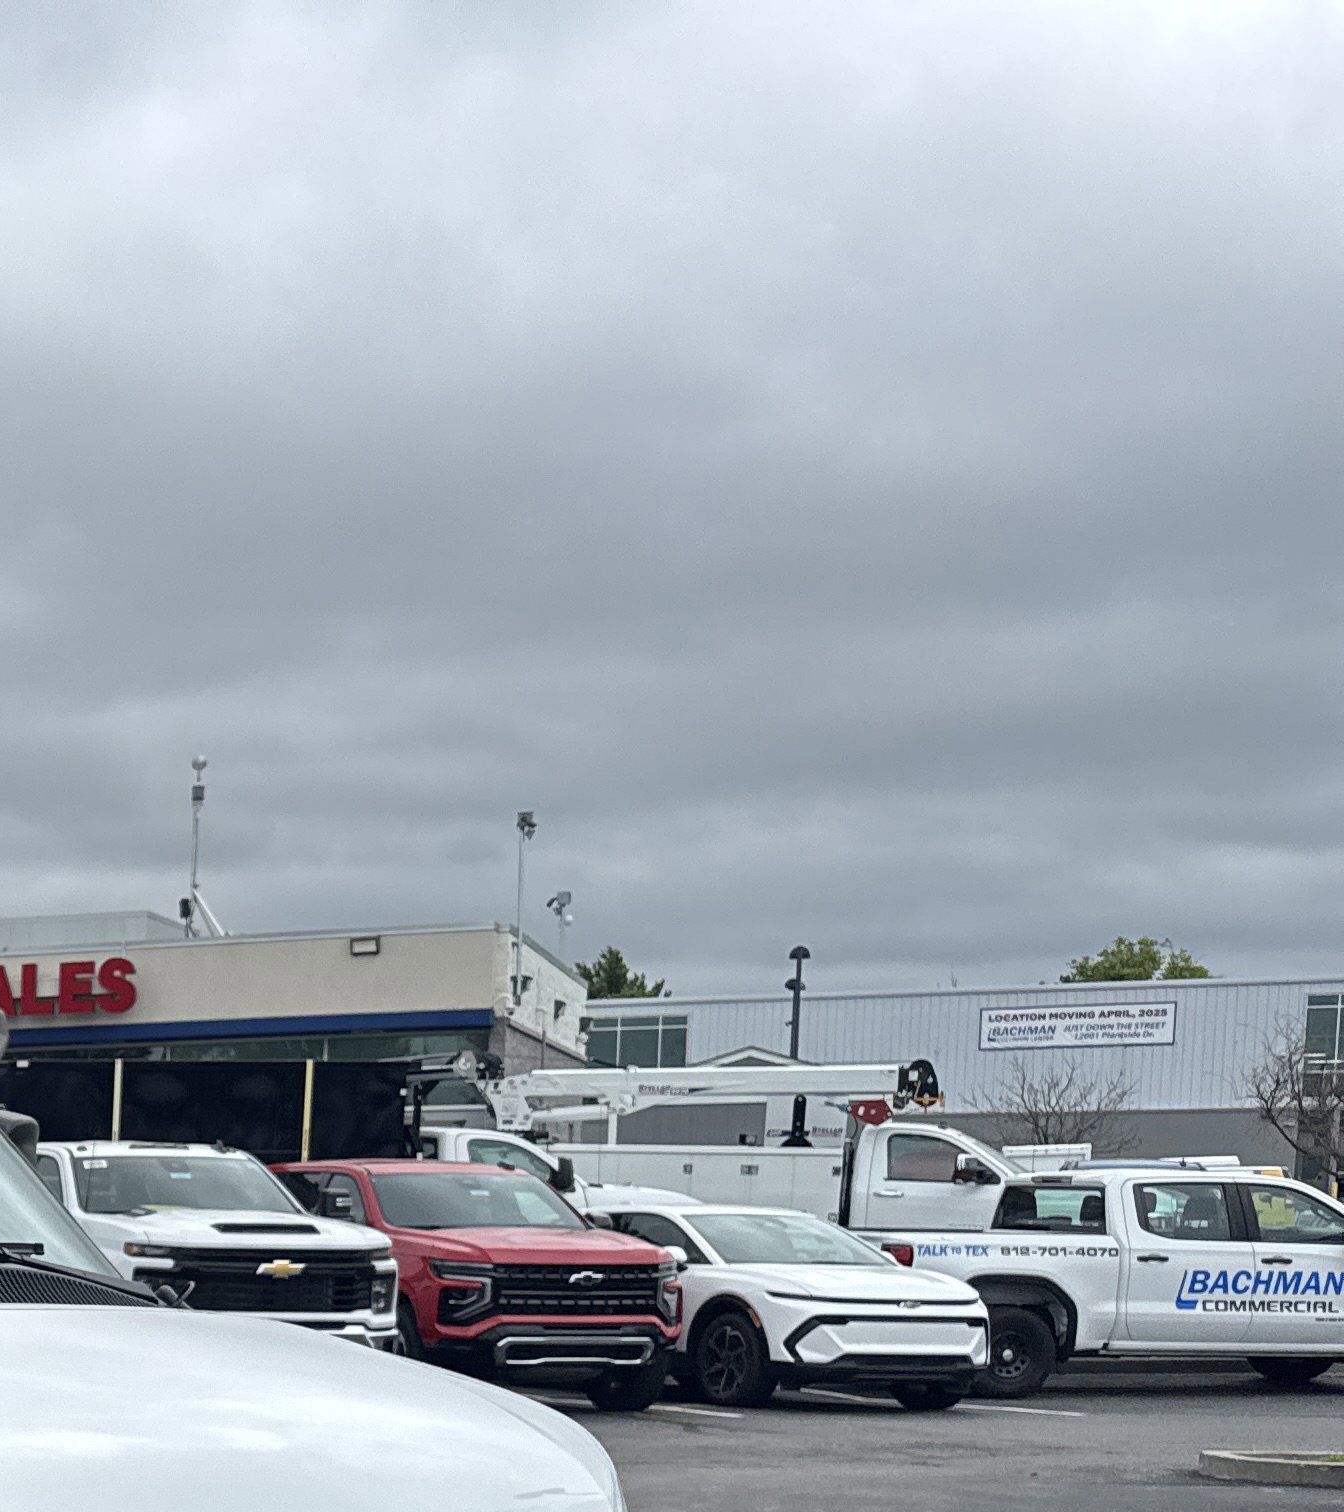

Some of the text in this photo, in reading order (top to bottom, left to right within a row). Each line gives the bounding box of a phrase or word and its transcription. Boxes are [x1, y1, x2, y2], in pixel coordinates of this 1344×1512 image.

[988, 1013, 1046, 1023] LOCATION
[1049, 1011, 1095, 1020] MOVING
[1098, 1009, 1136, 1019] APRIL,
[992, 1025, 1057, 1036] BACHMAN
[1086, 1023, 1115, 1031] DOWN
[916, 1244, 949, 1257] TALK
[951, 1246, 962, 1255] TO
[964, 1244, 989, 1257] TEX
[1187, 1270, 1344, 1295] BACHMAN
[1202, 1299, 1339, 1313] COMMERCIAL
